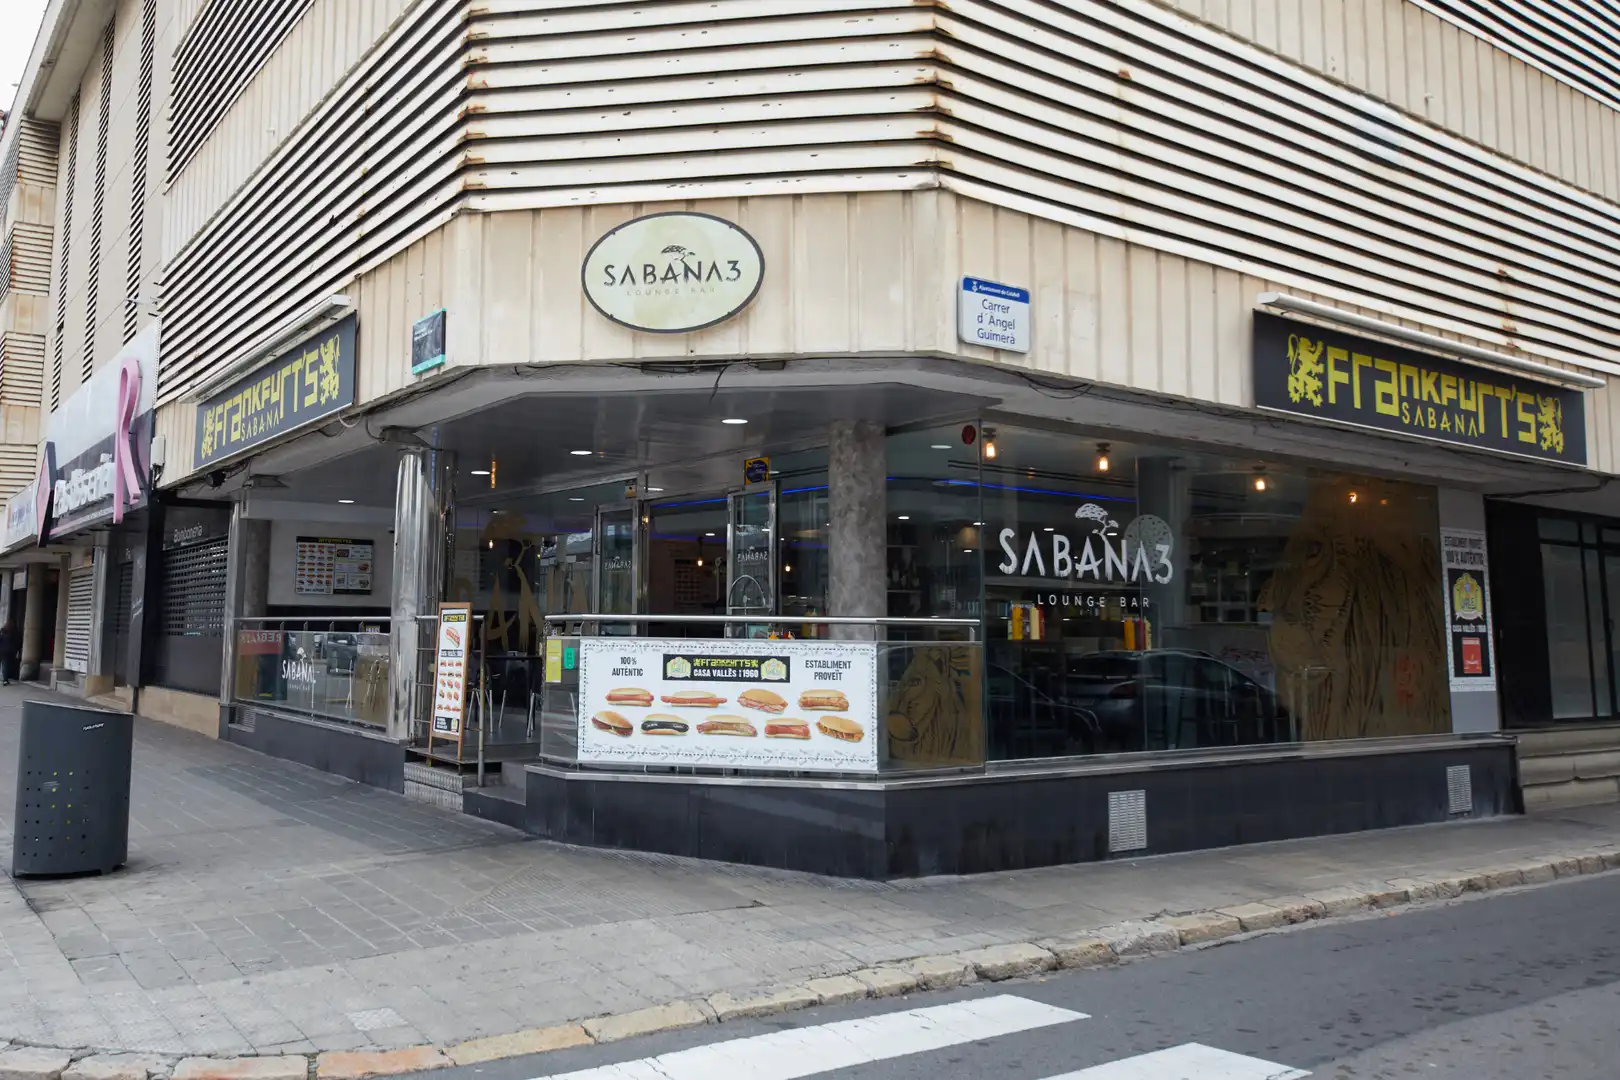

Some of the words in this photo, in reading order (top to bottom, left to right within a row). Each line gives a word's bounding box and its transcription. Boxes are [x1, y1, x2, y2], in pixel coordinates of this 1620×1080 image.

[603, 260, 742, 287] SABANA3
[626, 287, 680, 296] LOUNGE
[691, 287, 716, 295] BAR
[981, 298, 1011, 314] Carrer
[976, 327, 1016, 345] Guimerà
[240, 406, 280, 442] SABANA
[1401, 404, 1480, 438] SABANA
[998, 527, 1174, 585] SABANA3
[1037, 593, 1106, 608] LOUNGE
[1120, 596, 1150, 608] BAR
[611, 666, 644, 677] AUTÈNTIC
[805, 659, 852, 670] ESTABLIMENT
[693, 668, 711, 677] CASA
[712, 667, 738, 678] VALLÈS
[742, 668, 759, 678] 1960
[813, 669, 843, 682] PROVEÏT
